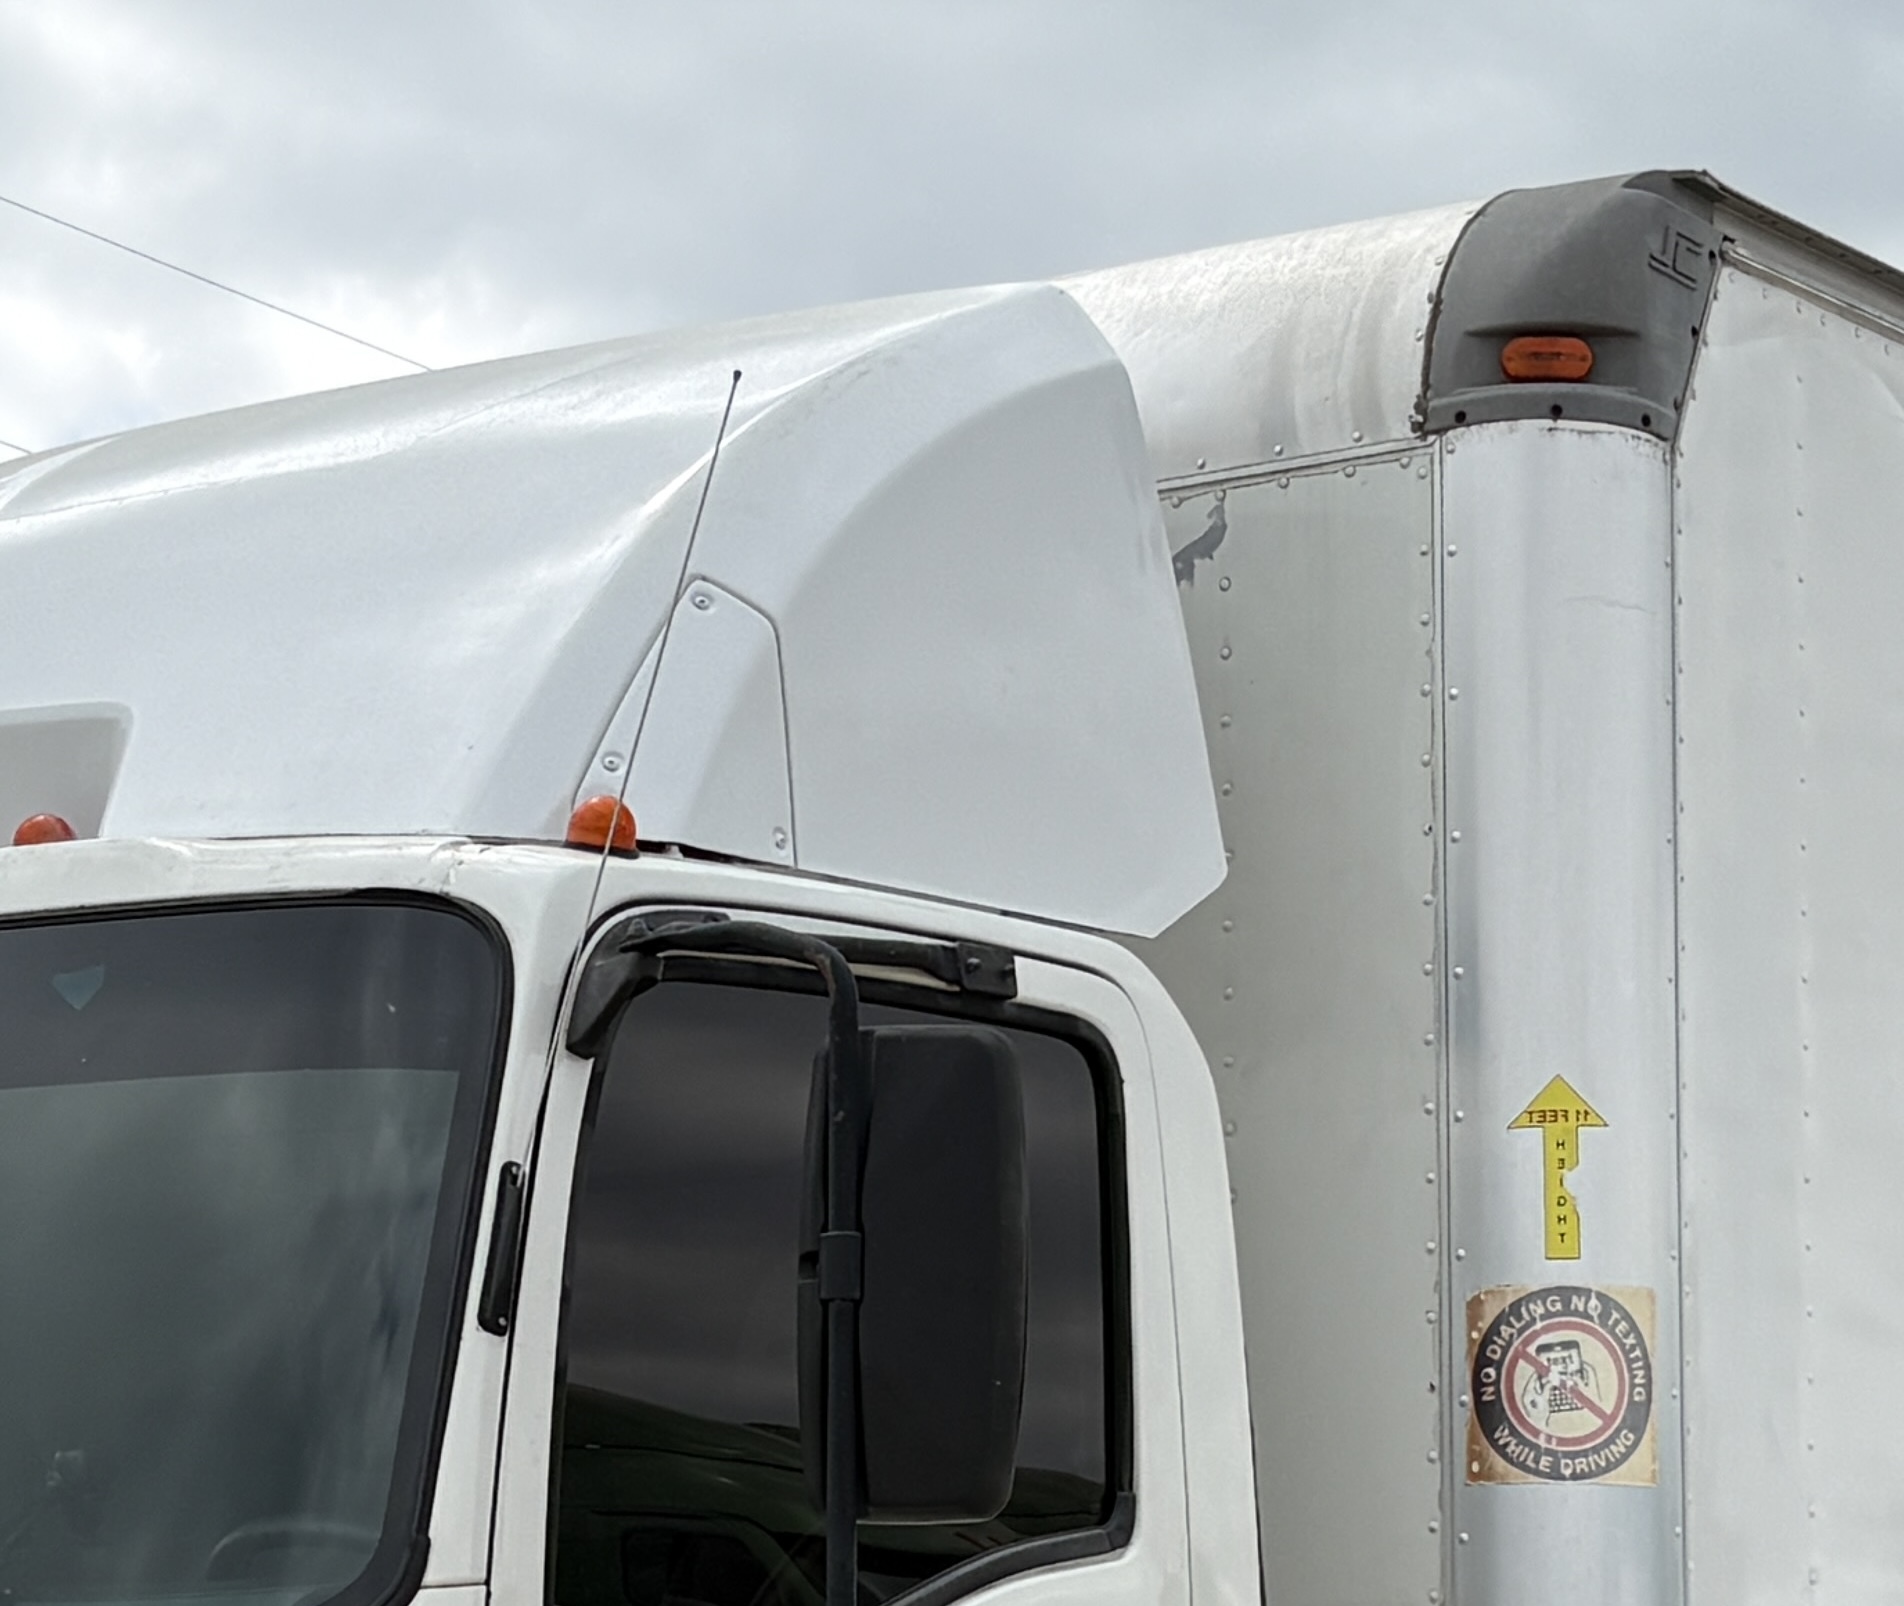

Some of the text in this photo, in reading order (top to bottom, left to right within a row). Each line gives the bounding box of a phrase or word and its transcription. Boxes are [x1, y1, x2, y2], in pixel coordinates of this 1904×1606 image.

[1479, 1294, 1648, 1403] NO DIALING NO TEXTING
[1492, 1424, 1636, 1478] WHILE DRIVING
